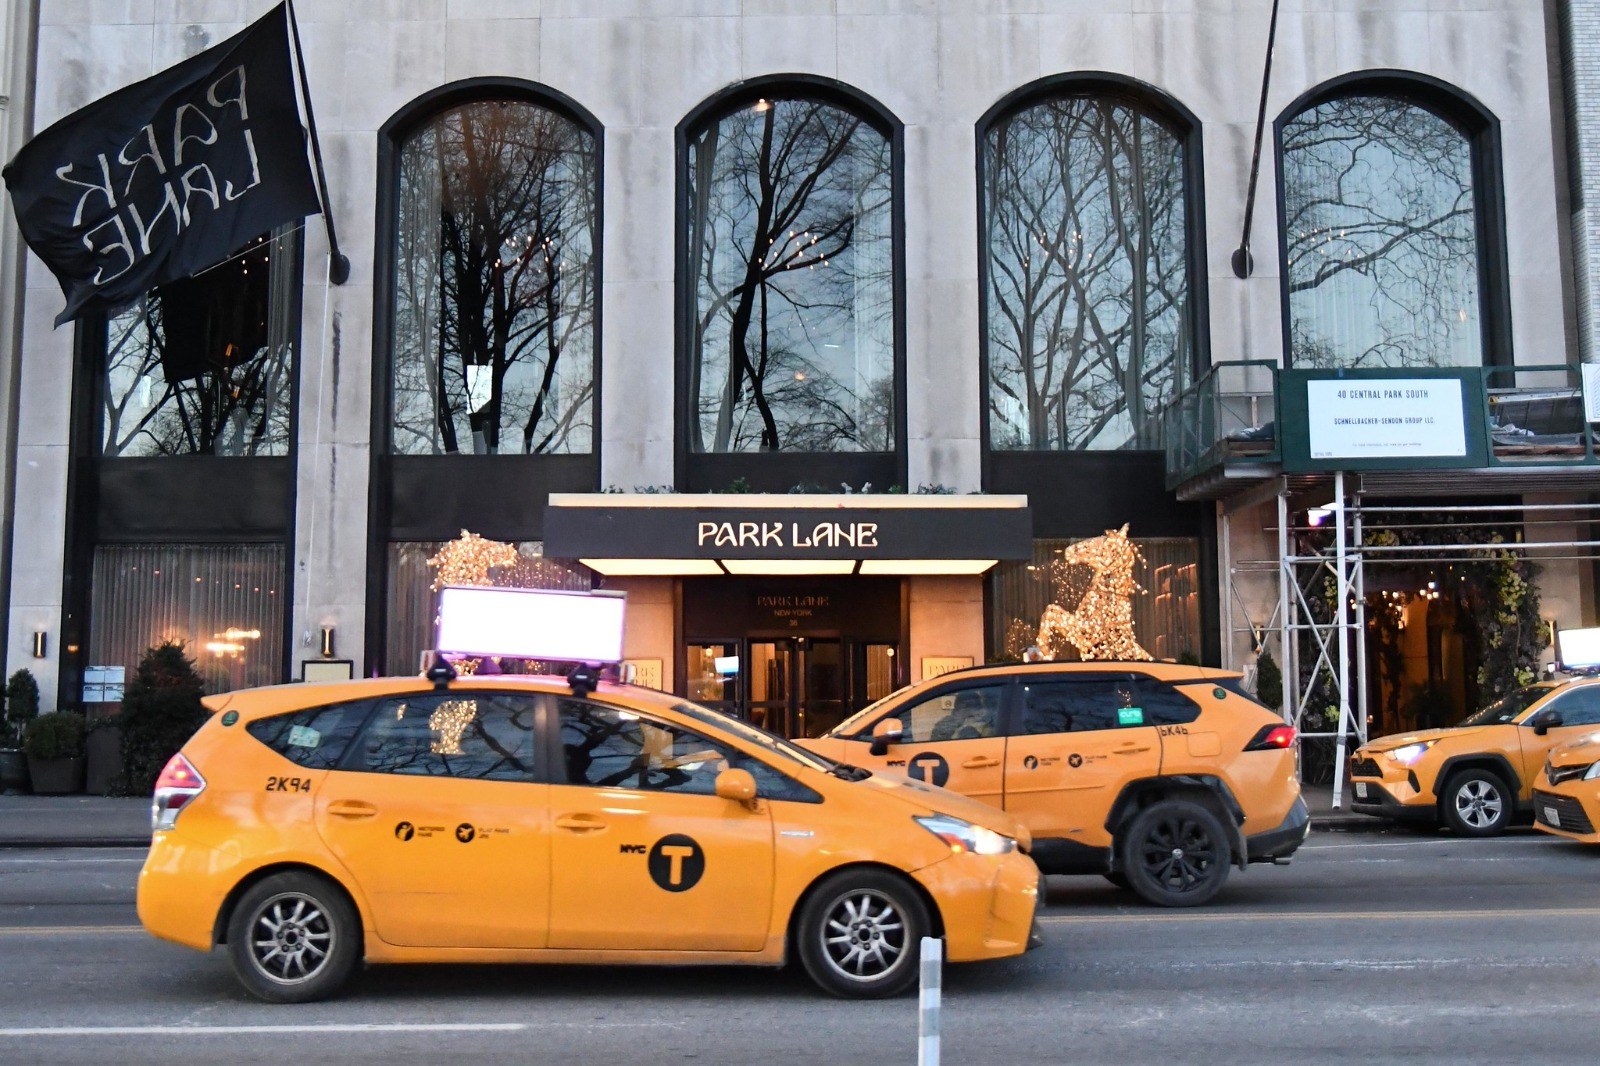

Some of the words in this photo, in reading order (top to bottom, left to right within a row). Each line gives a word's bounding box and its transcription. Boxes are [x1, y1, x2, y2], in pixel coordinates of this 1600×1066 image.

[1337, 390, 1347, 399] 40
[1350, 390, 1381, 399] CENTRAL
[1384, 390, 1403, 399] PARK
[1405, 389, 1429, 398] SOUTH
[698, 522, 784, 547] PARK
[792, 522, 878, 547] LANE
[757, 596, 792, 606] PARK
[795, 596, 829, 606] LANE
[265, 776, 312, 792] 2K94
[620, 844, 647, 854] NYC
[661, 845, 694, 885] T
